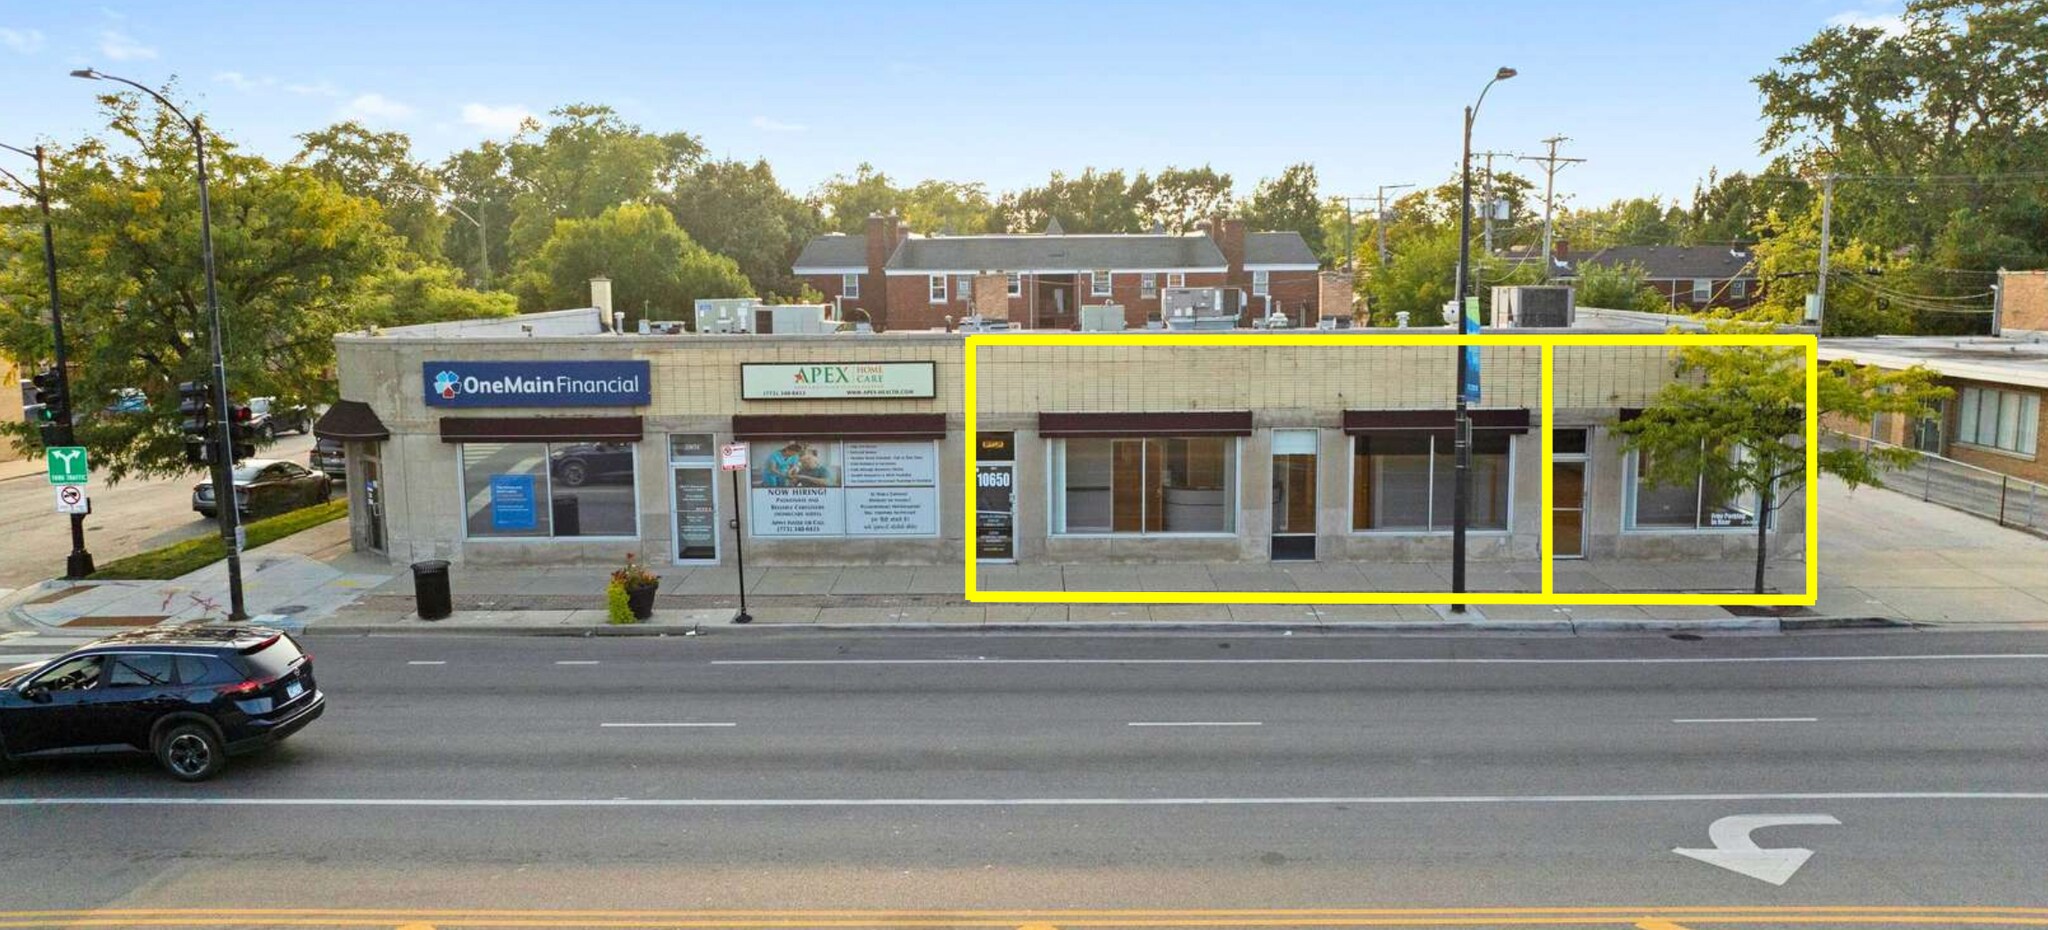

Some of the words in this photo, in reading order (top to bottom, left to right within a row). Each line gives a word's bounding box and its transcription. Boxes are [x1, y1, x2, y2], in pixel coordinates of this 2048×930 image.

[795, 366, 849, 384] APEX
[857, 366, 883, 374] HOME
[463, 376, 554, 394] OneMain
[557, 375, 639, 393] Financial
[857, 375, 883, 383] CARE
[977, 472, 1010, 487] 10650
